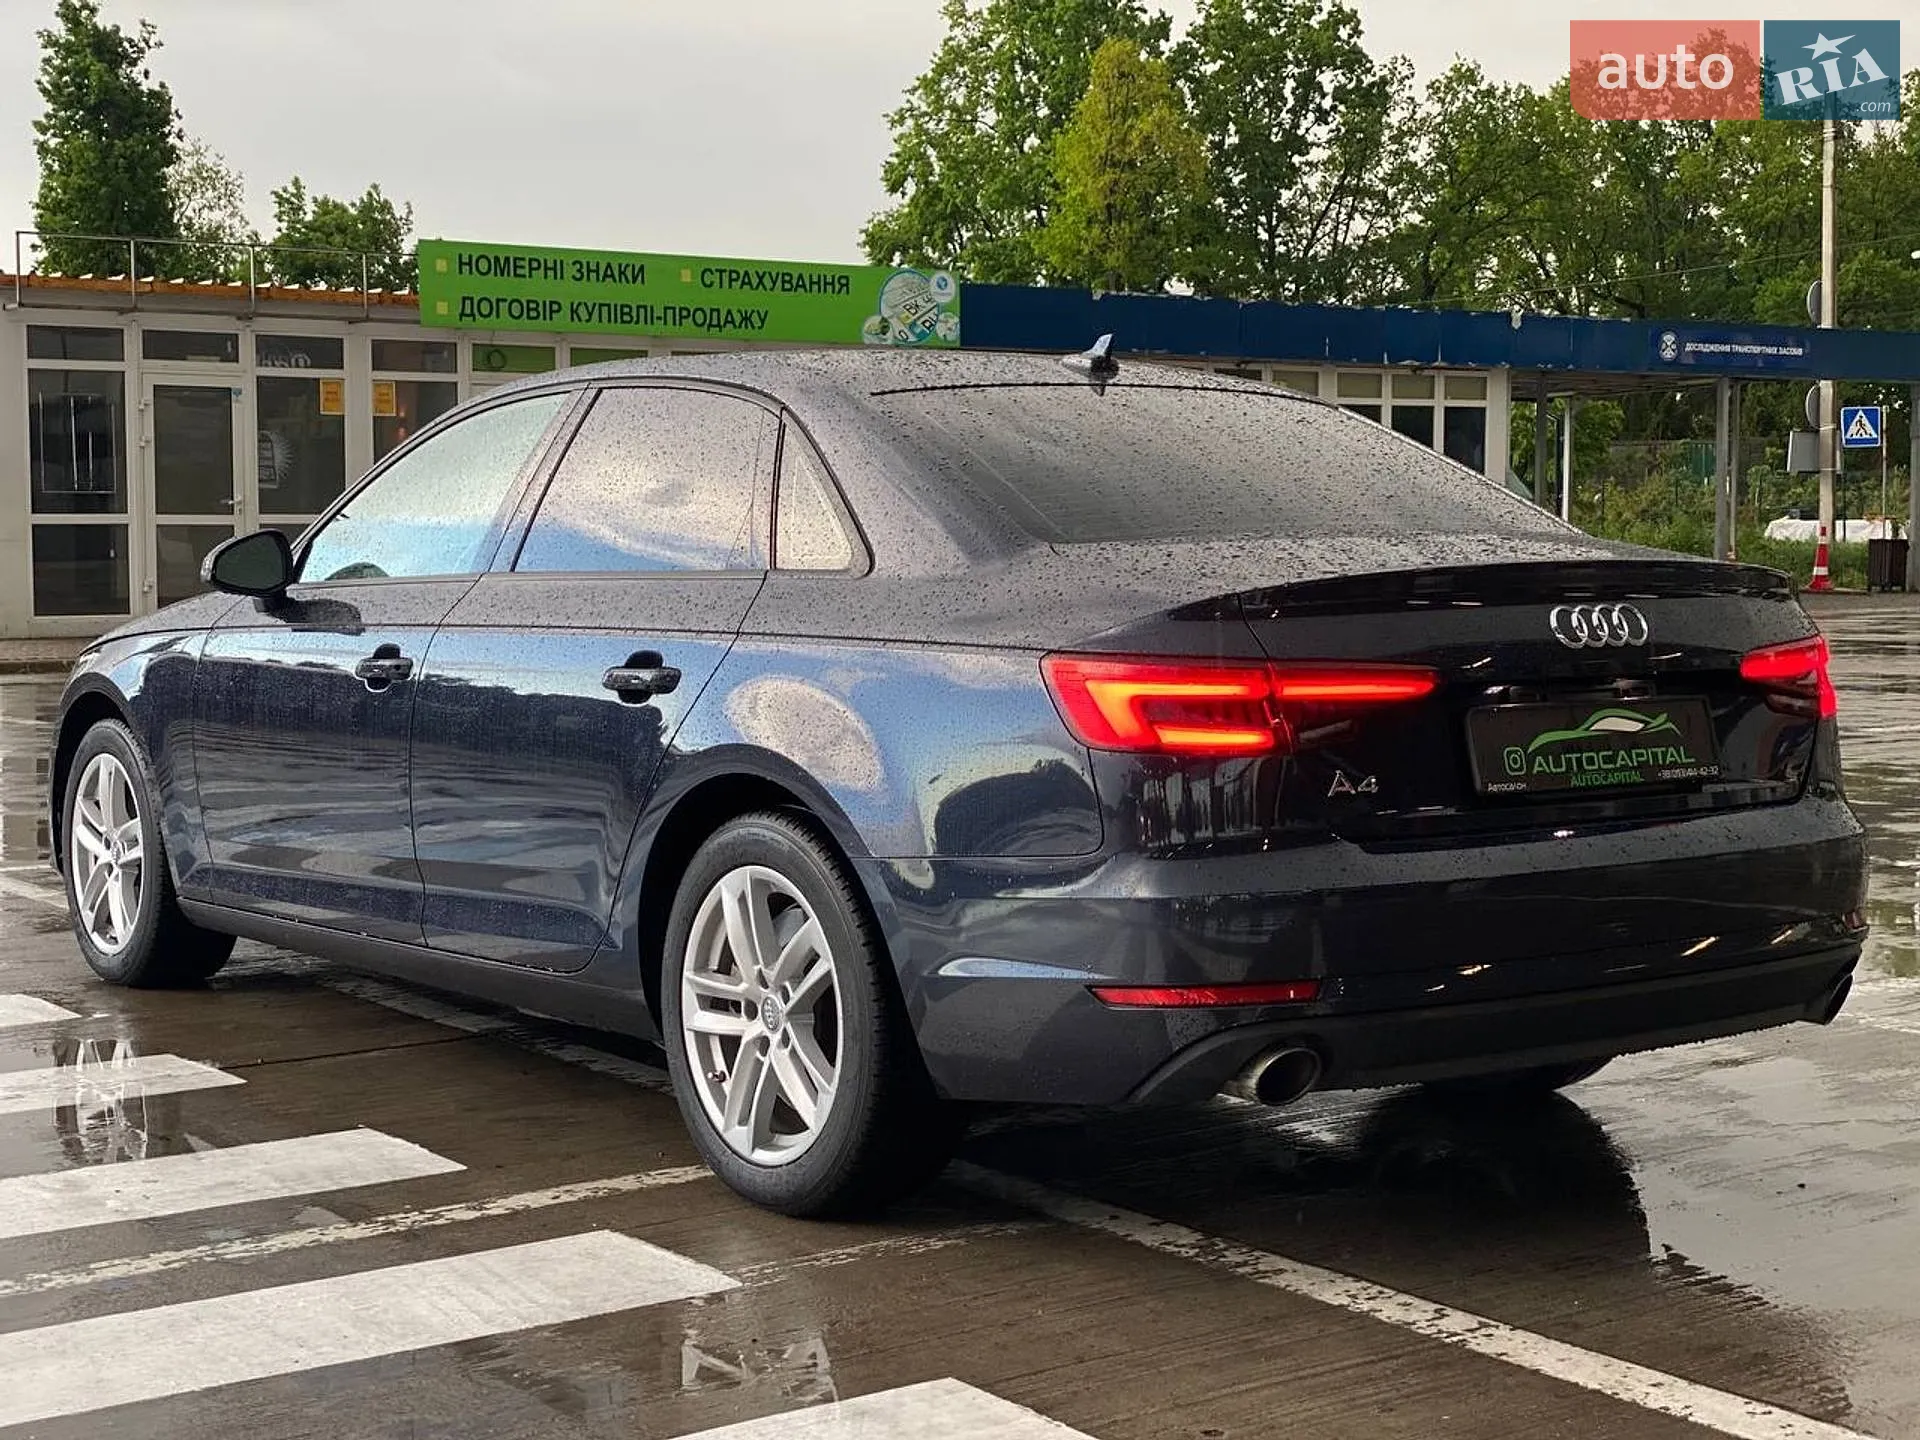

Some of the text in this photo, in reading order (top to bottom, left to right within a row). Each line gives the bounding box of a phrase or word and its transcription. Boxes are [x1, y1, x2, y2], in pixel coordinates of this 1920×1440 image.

[458, 253, 646, 286] НОМЕРНІ ЗНАКИ
[700, 268, 851, 295] СТРАХУВАННЯ
[458, 295, 770, 332] ДОГОВІР КУПІВЛІ-ПРОДАЖУ
[1531, 746, 1697, 776] AUTOCAPITAL
[1327, 769, 1379, 798] A4
[1571, 770, 1645, 787] AUTOCAPITAL
